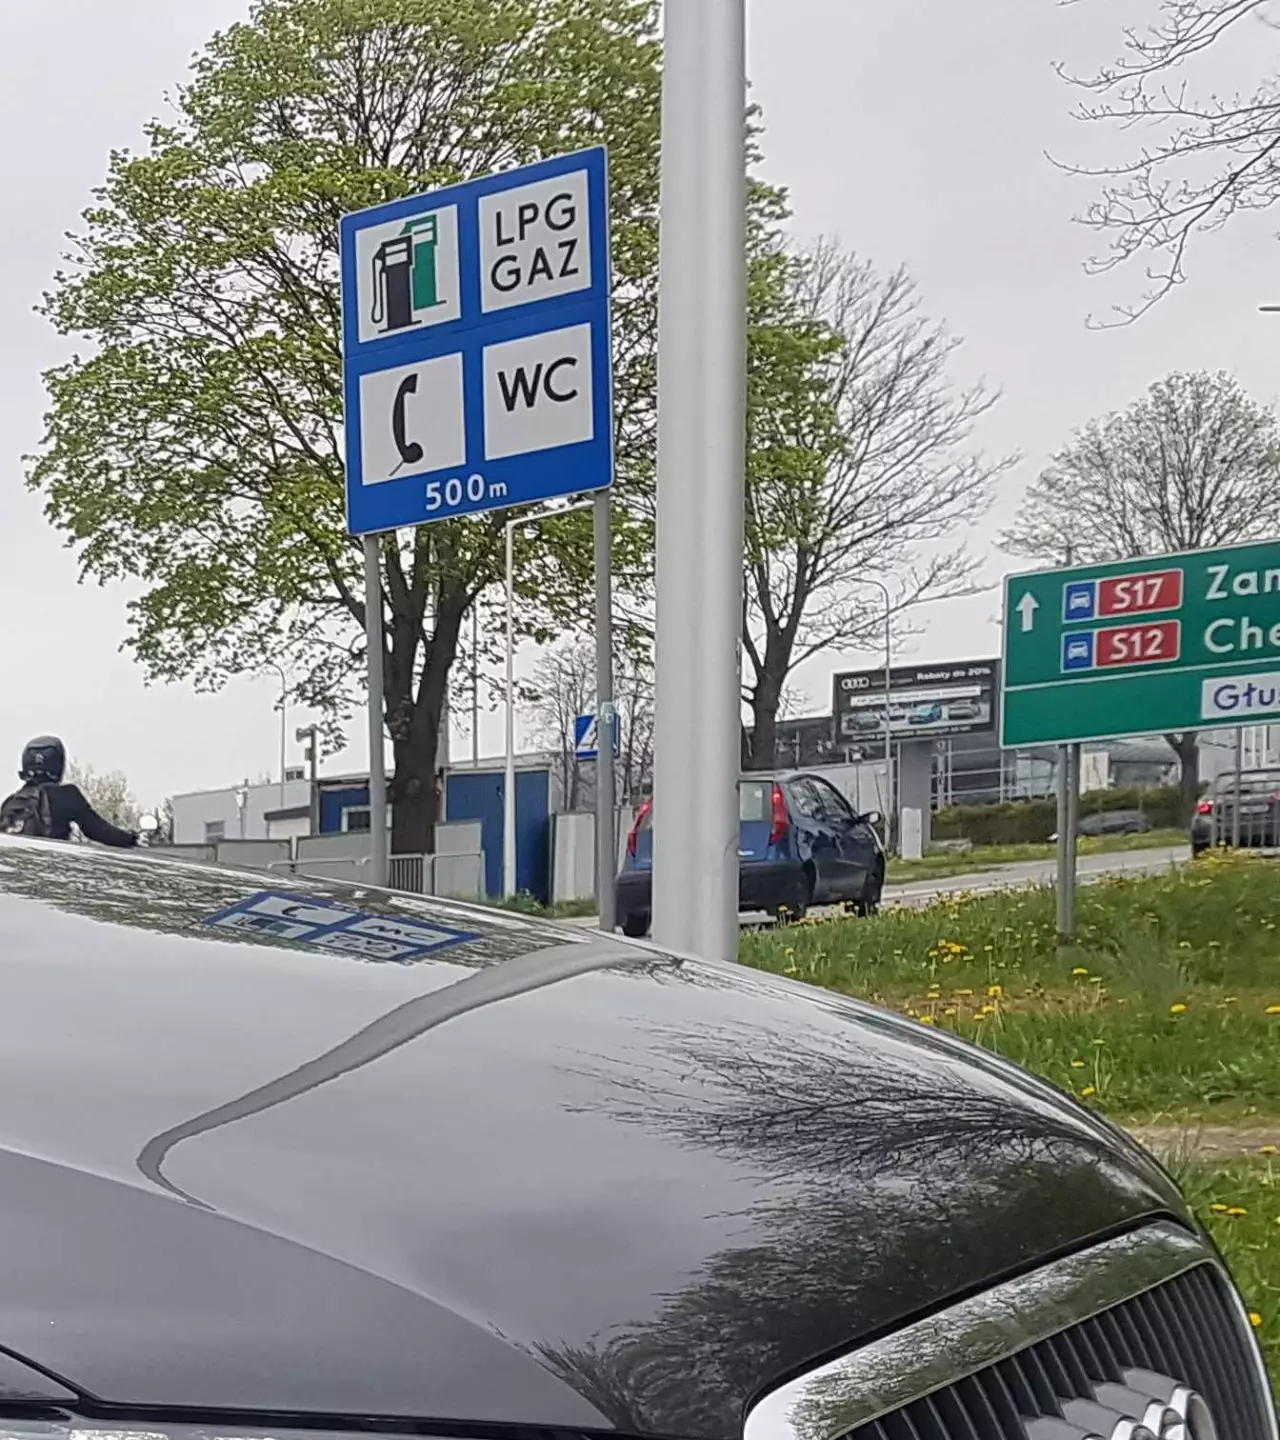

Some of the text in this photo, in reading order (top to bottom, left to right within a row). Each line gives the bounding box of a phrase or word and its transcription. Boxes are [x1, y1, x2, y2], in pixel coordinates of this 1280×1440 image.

[495, 192, 577, 247] LPG
[491, 239, 579, 292] GAZ
[497, 356, 578, 412] WC
[1111, 577, 1164, 610] S17
[1109, 628, 1164, 661] S12
[1213, 682, 1280, 711] Głu
